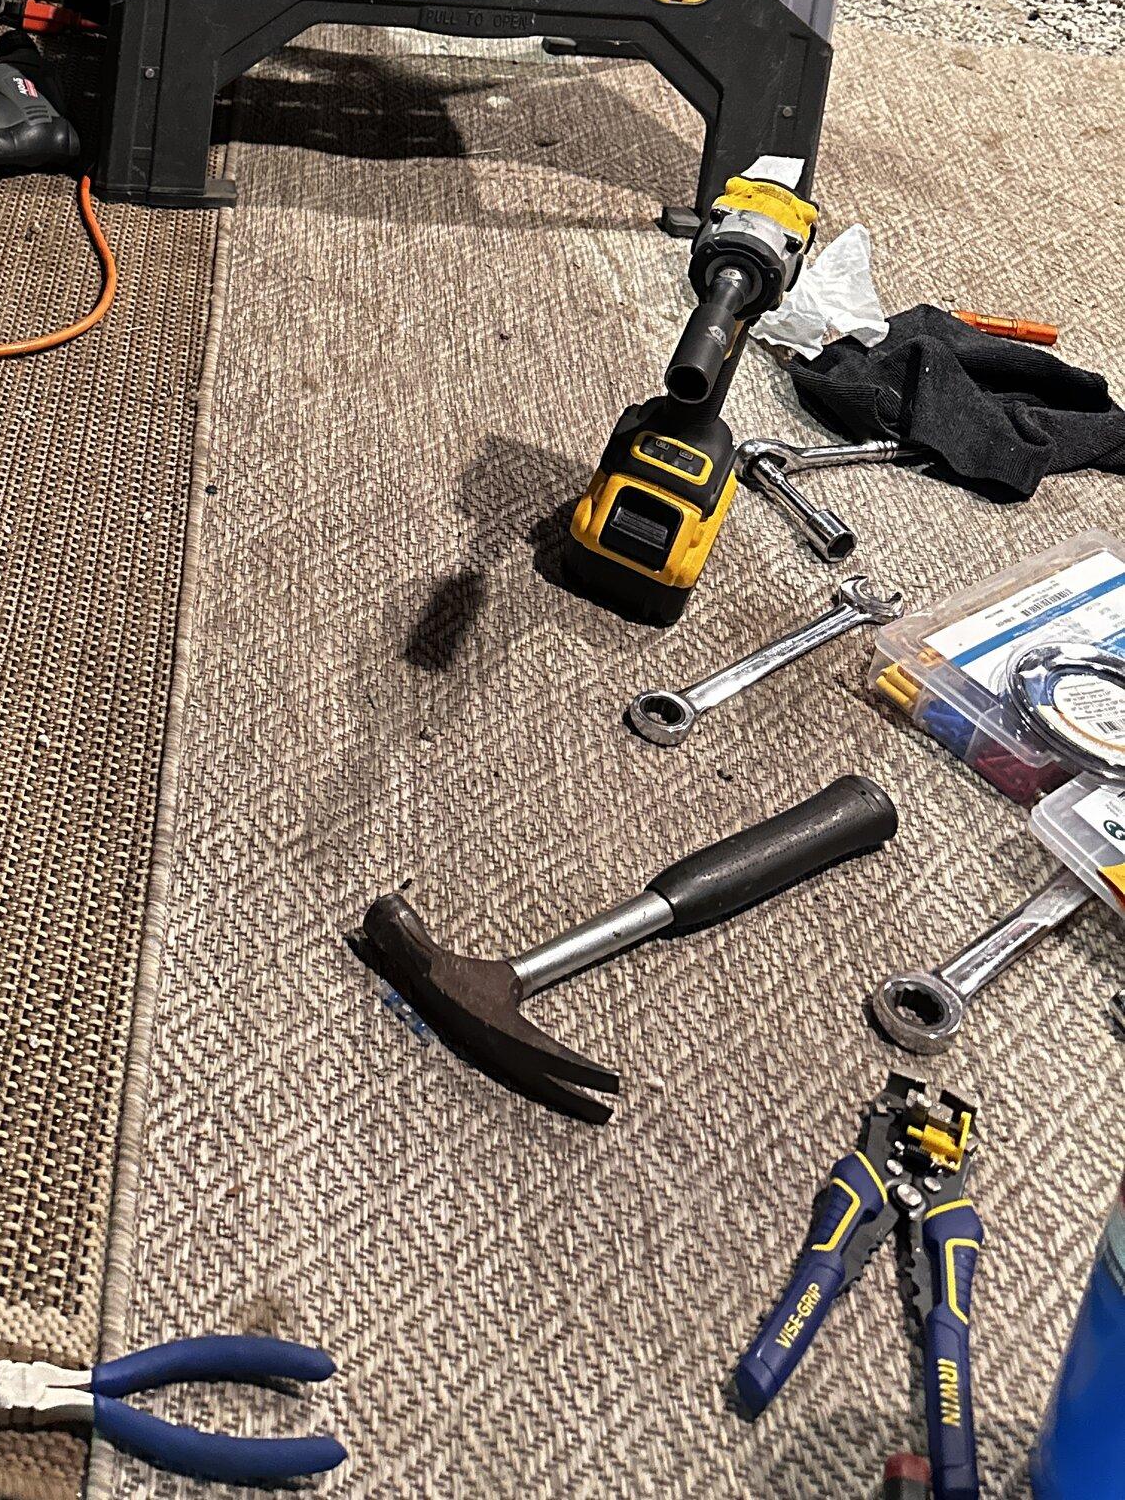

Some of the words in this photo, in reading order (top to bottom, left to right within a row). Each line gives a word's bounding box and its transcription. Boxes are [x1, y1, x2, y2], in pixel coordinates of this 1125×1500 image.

[426, 8, 458, 26] PULL
[467, 10, 484, 27] TO
[493, 13, 531, 30] OPEN
[775, 1282, 822, 1349] VISE-GRIP
[937, 1357, 971, 1428] IRWIN
